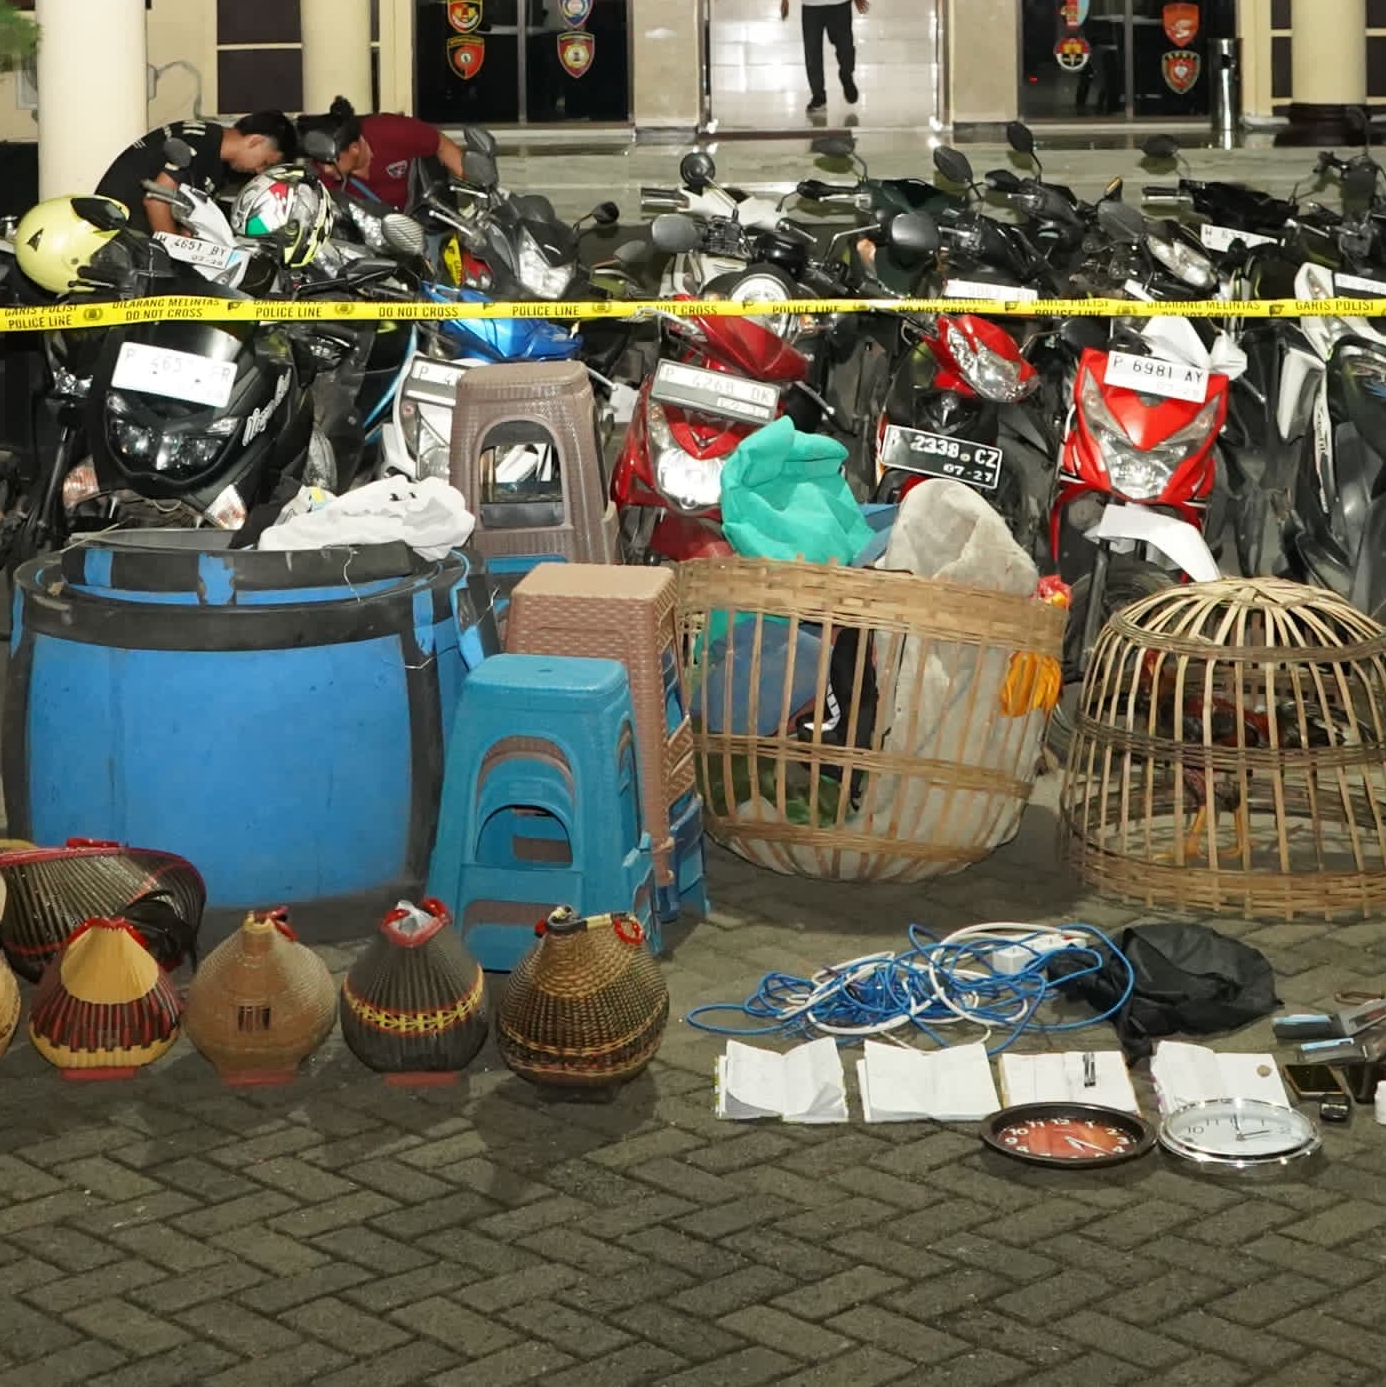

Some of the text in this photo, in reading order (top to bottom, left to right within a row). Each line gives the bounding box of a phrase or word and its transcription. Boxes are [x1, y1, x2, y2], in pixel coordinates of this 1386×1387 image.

[379, 305, 459, 318] DO NOT CROSS
[512, 304, 580, 317] POLICE LINE
[680, 304, 718, 316] CROSS
[772, 305, 811, 314] POLICE
[1295, 300, 1374, 311] GARIS POLISI
[125, 308, 204, 321] DO NOT CROSS
[255, 306, 322, 319] POLICE LINE
[8, 316, 73, 330] POLICE LINE
[1113, 355, 1203, 383] P 6981 AY
[914, 435, 960, 458] 2338
[974, 449, 999, 468] CZ
